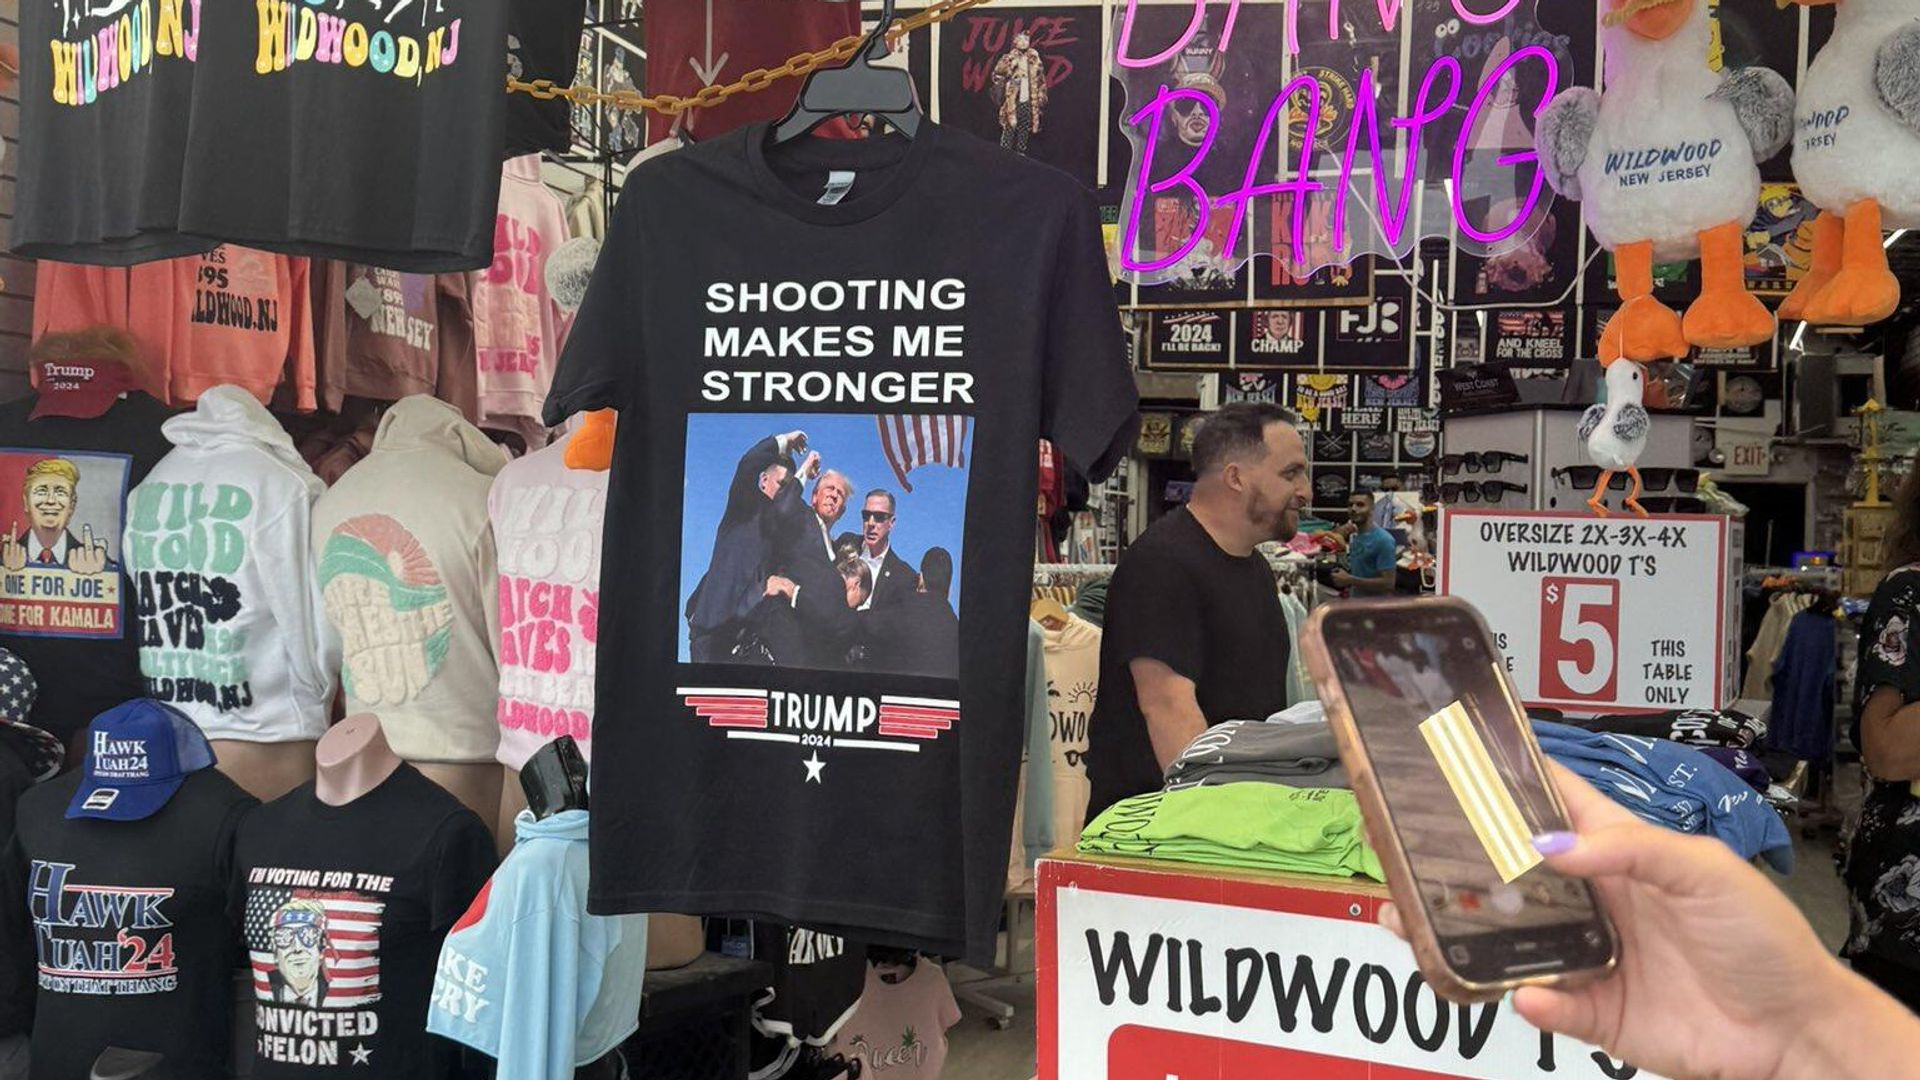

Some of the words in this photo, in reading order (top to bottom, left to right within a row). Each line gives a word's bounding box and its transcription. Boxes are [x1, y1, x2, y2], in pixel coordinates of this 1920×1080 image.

[1122, 46, 1559, 271] BANG
[1604, 138, 1722, 175] WILDWOOD
[1619, 172, 1649, 187] NEW
[1658, 163, 1711, 182] JERSEY
[705, 278, 966, 313] SHOOTING
[704, 325, 875, 357] MAKES
[892, 325, 965, 357] ME
[1170, 324, 1213, 343] 2024
[1251, 338, 1304, 353] CHAMP
[1497, 338, 1521, 349] AND
[1525, 338, 1561, 349] KNEEL
[1496, 348, 1514, 358] FOR
[1517, 348, 1532, 358] THE
[1534, 347, 1564, 359] CROSS
[44, 362, 95, 380] Trump
[53, 382, 81, 391] 2024
[701, 370, 975, 403] STRONGER
[1341, 413, 1381, 425] HERE
[1734, 446, 1761, 465] EXIT
[1480, 522, 1574, 544] OVERSIZE
[1580, 525, 1687, 548] 2X-3X-4X
[1508, 551, 1622, 575] WILDWOOD
[1629, 555, 1657, 576] T'S
[4, 574, 25, 595] ONE
[31, 576, 65, 597] FOR
[70, 578, 104, 599] JOE
[19, 604, 45, 627] FOR
[50, 606, 114, 630] KAMALA
[1546, 583, 1559, 605] $
[1557, 583, 1614, 695] 5
[1651, 640, 1686, 658] THIS
[1643, 663, 1693, 681] TABLE
[1645, 686, 1690, 704] ONLY
[771, 691, 877, 733] TRUMP
[94, 730, 148, 755] HAWK
[801, 734, 832, 747] 2024
[267, 868, 321, 887] VOTING
[321, 871, 353, 889] FOR
[355, 872, 394, 893] THE
[28, 859, 174, 928] HAWK
[113, 972, 179, 995] THANG
[1085, 928, 1500, 1060] WILDWOOD
[264, 1033, 339, 1066] FELON
